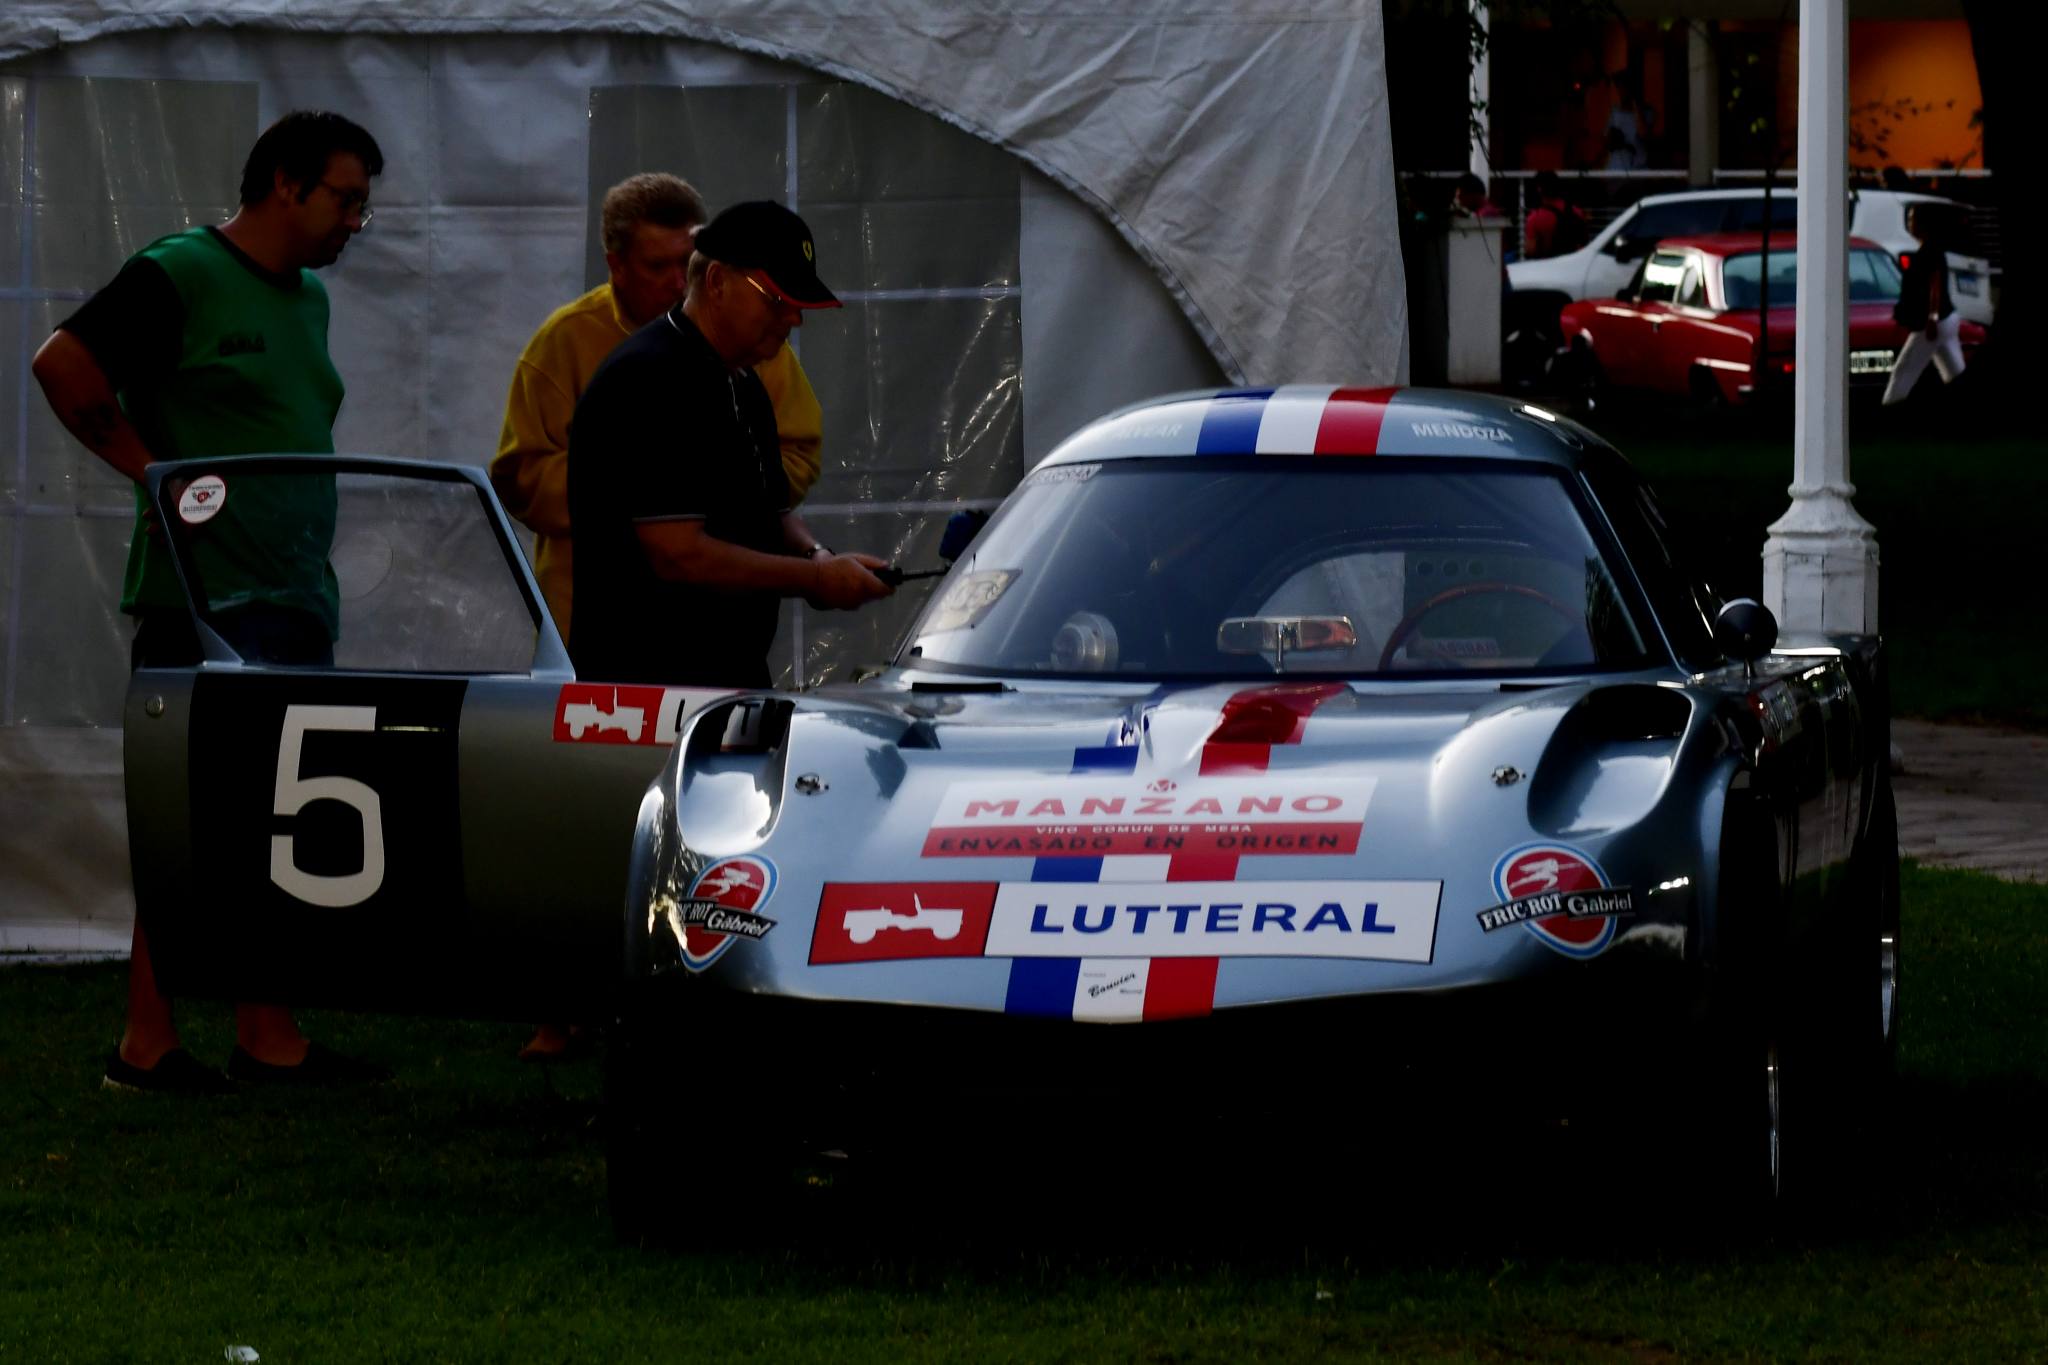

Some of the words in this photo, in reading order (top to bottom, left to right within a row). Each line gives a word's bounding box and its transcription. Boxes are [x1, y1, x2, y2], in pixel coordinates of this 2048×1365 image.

[1411, 423, 1513, 442] MENDOZA
[270, 704, 385, 908] 5
[963, 795, 1344, 818] MANZANO
[939, 835, 1113, 851] ENVASADO
[1143, 833, 1185, 849] EN
[1216, 832, 1339, 848] ORIGEN
[1036, 825, 1078, 835] VINO
[1567, 891, 1632, 915] Gabriel
[706, 909, 772, 936] Gabriel
[1030, 902, 1397, 934] LUTTERAL
